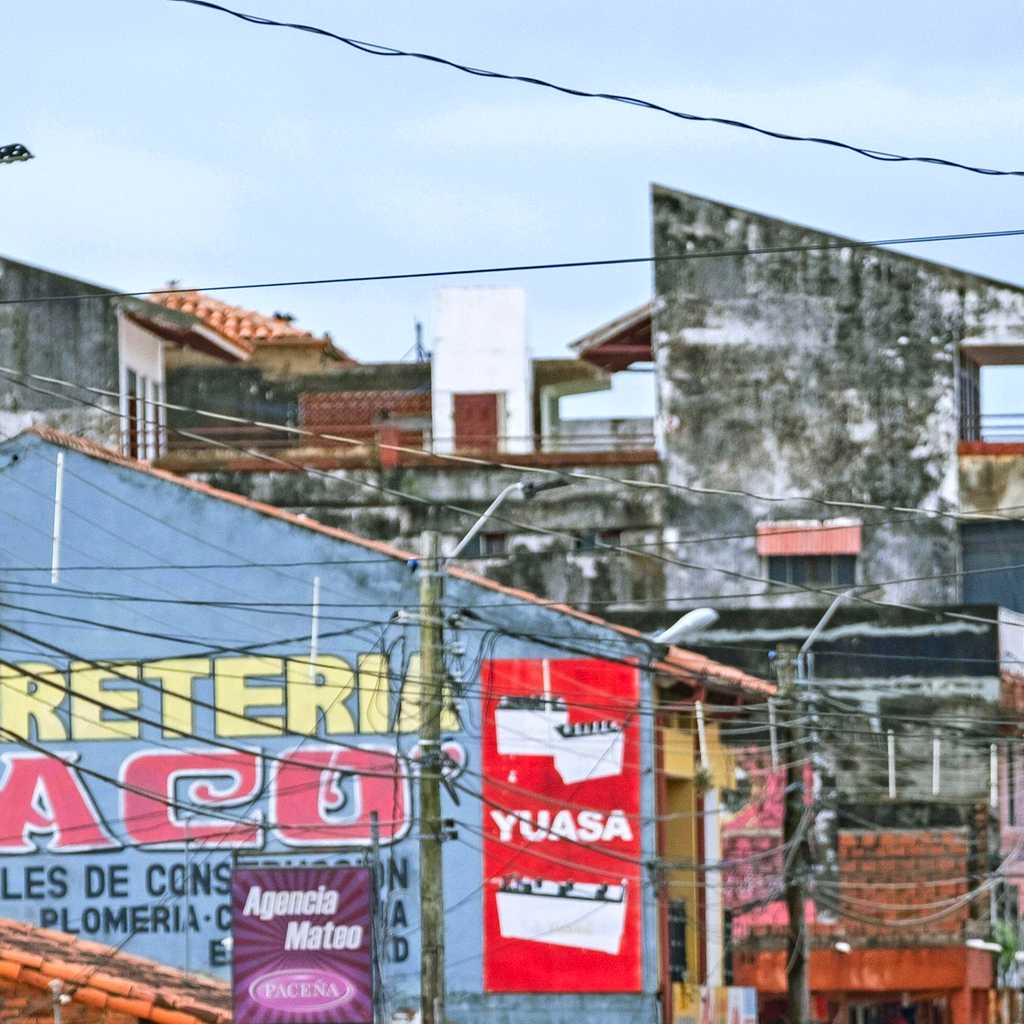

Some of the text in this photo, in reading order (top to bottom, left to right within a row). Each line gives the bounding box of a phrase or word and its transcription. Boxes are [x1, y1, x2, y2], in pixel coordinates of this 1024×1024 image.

[490, 810, 633, 842] YUASA
[1, 866, 68, 899] LES
[85, 864, 129, 898] DE
[243, 885, 339, 920] Agencia
[284, 921, 363, 950] Mateo
[265, 979, 340, 998] PACEÑA
